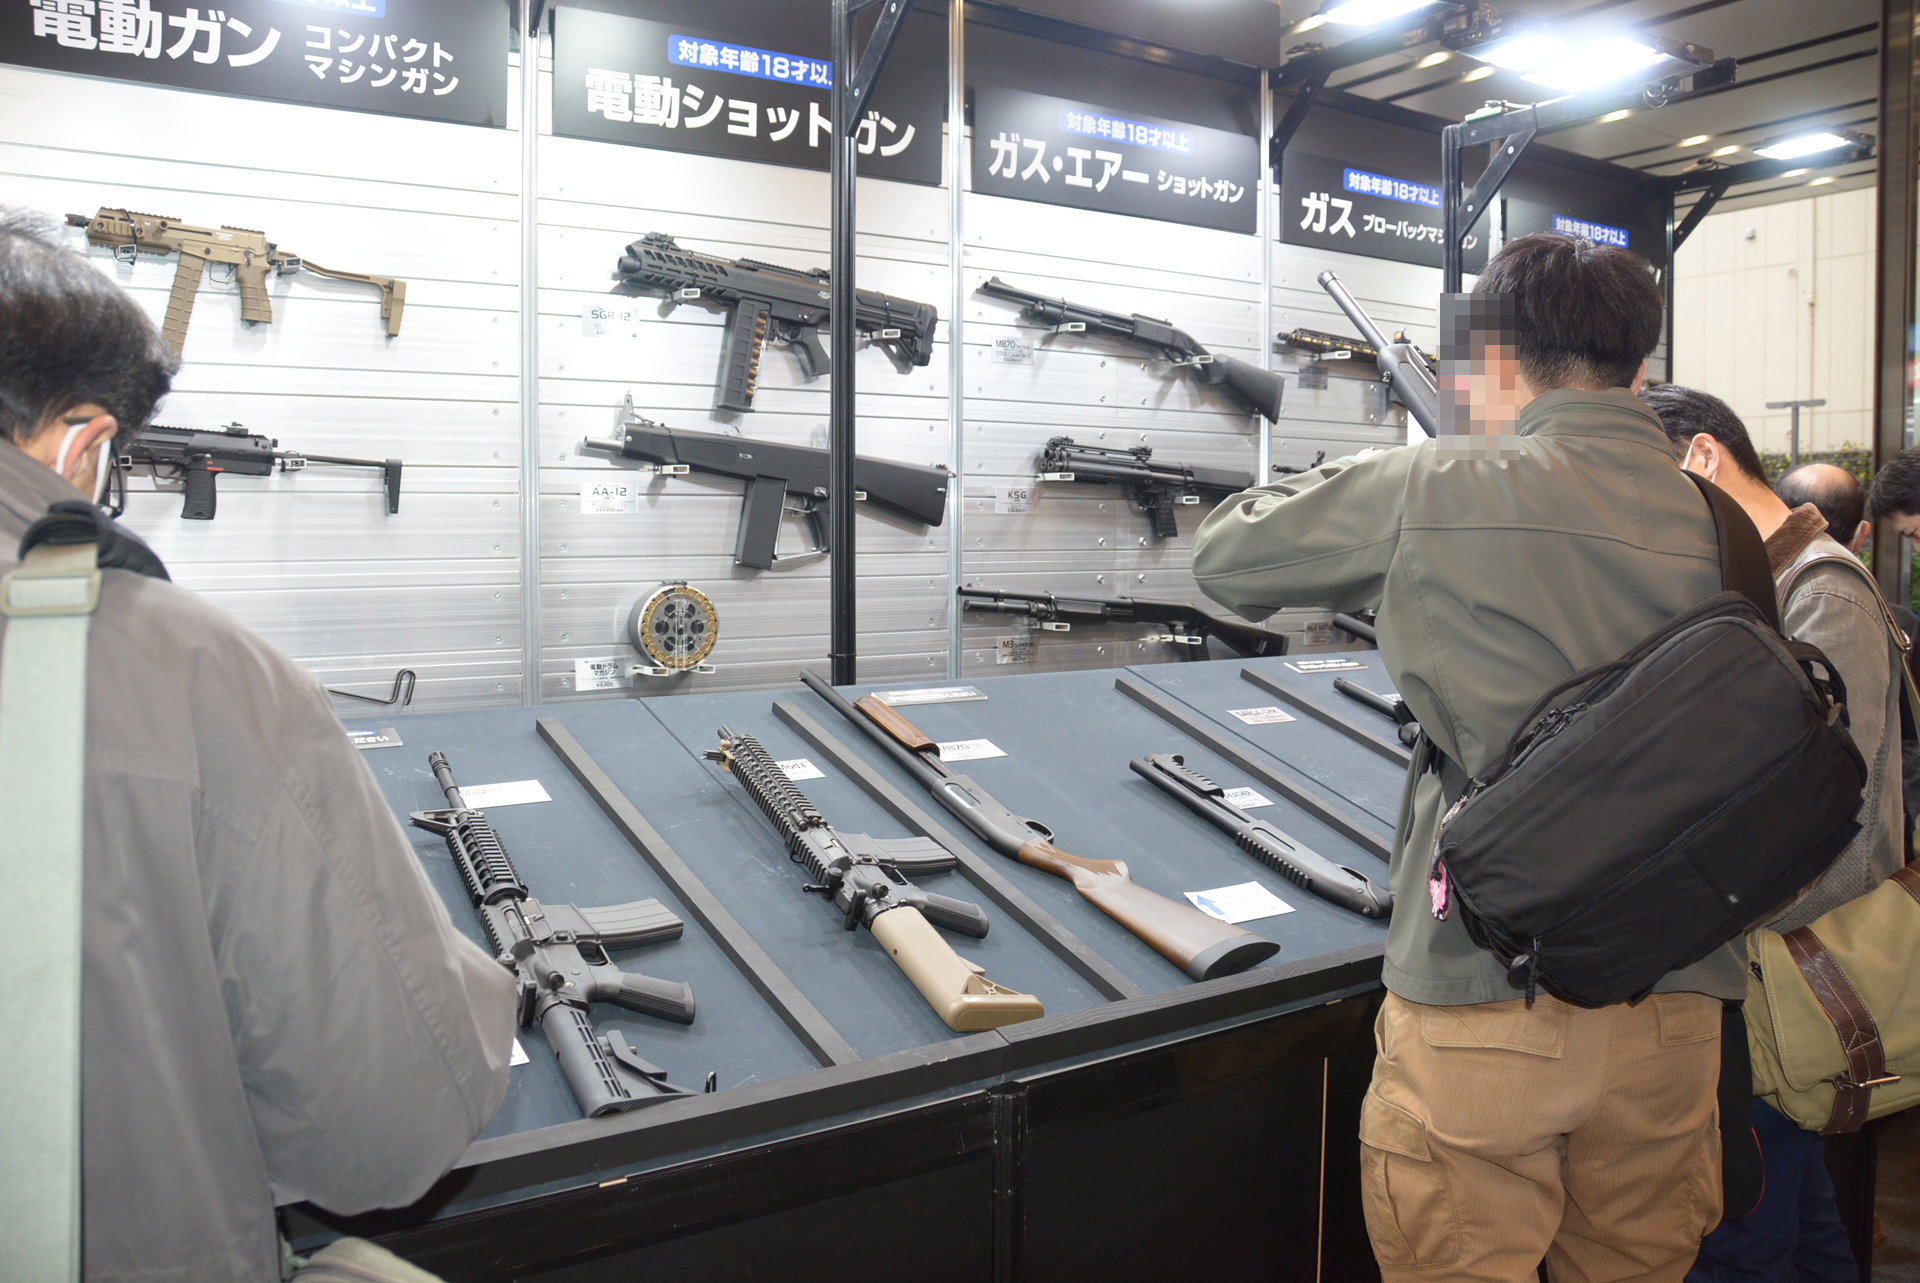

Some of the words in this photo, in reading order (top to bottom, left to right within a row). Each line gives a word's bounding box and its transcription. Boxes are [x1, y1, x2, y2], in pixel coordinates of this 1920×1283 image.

[305, 24, 454, 68] コンパクト
[678, 39, 832, 86] 対象年齢18才以
[304, 54, 459, 96] マシンガン
[584, 67, 916, 157] 電動ショットガン
[1066, 111, 1190, 151] 対象年齢18才以上
[988, 131, 1150, 193] ガス・エアー
[1156, 169, 1245, 203] ショットガン
[1348, 172, 1441, 206] 対象年齢18才以上
[1300, 191, 1356, 239] ガス
[1362, 213, 1478, 250] ブローバックマシン
[1555, 217, 1626, 246] 対象年齢18才以上
[591, 309, 631, 321] SGR-12
[995, 340, 1015, 349] M870
[592, 487, 627, 496] AA-12
[1007, 491, 1027, 499] KSG
